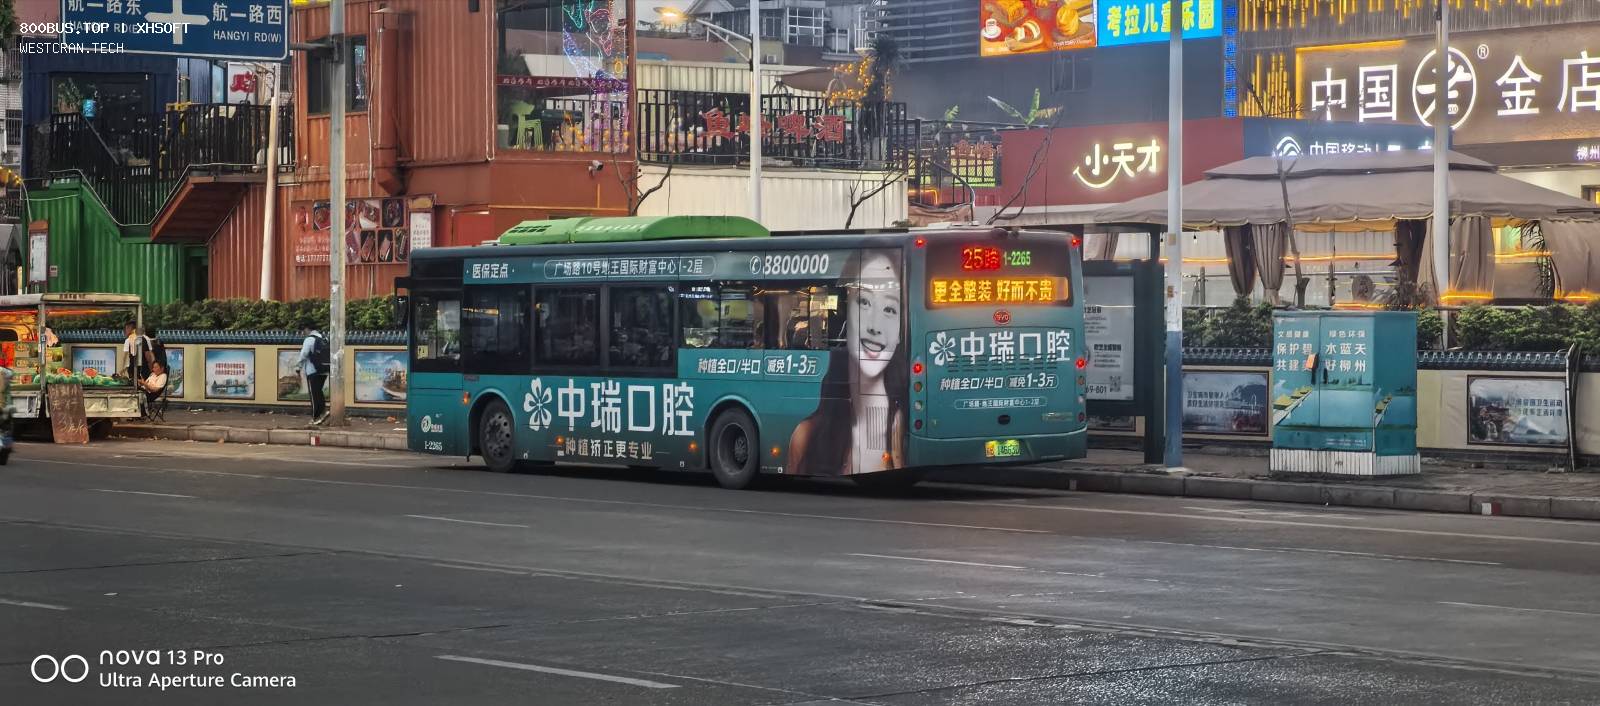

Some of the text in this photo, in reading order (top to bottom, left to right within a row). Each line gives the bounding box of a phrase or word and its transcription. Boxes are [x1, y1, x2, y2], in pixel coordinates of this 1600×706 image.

[68, 0, 141, 15] 航一路东
[213, 3, 282, 24] 航一路西
[1107, 0, 1214, 36] 考拉儿童乐园
[213, 30, 281, 42] HANGYI RD(W)
[1085, 139, 1161, 178] 小天才
[963, 248, 999, 270] 25路
[1003, 251, 1031, 266] 1-2265
[472, 263, 509, 279] 医保定点
[933, 279, 1052, 303] 更全整装 好而不贵
[960, 330, 1071, 365] 中瑞口腔
[1325, 342, 1366, 355] 水蓝天
[697, 354, 817, 375] 种植全口/半口 减免1-3万
[1324, 359, 1366, 373] 好柳州
[940, 373, 1055, 391] 种植全口/半口 减免1-3万
[557, 378, 695, 437] 中瑞口腔
[565, 437, 653, 460] 种植矫正更专业
